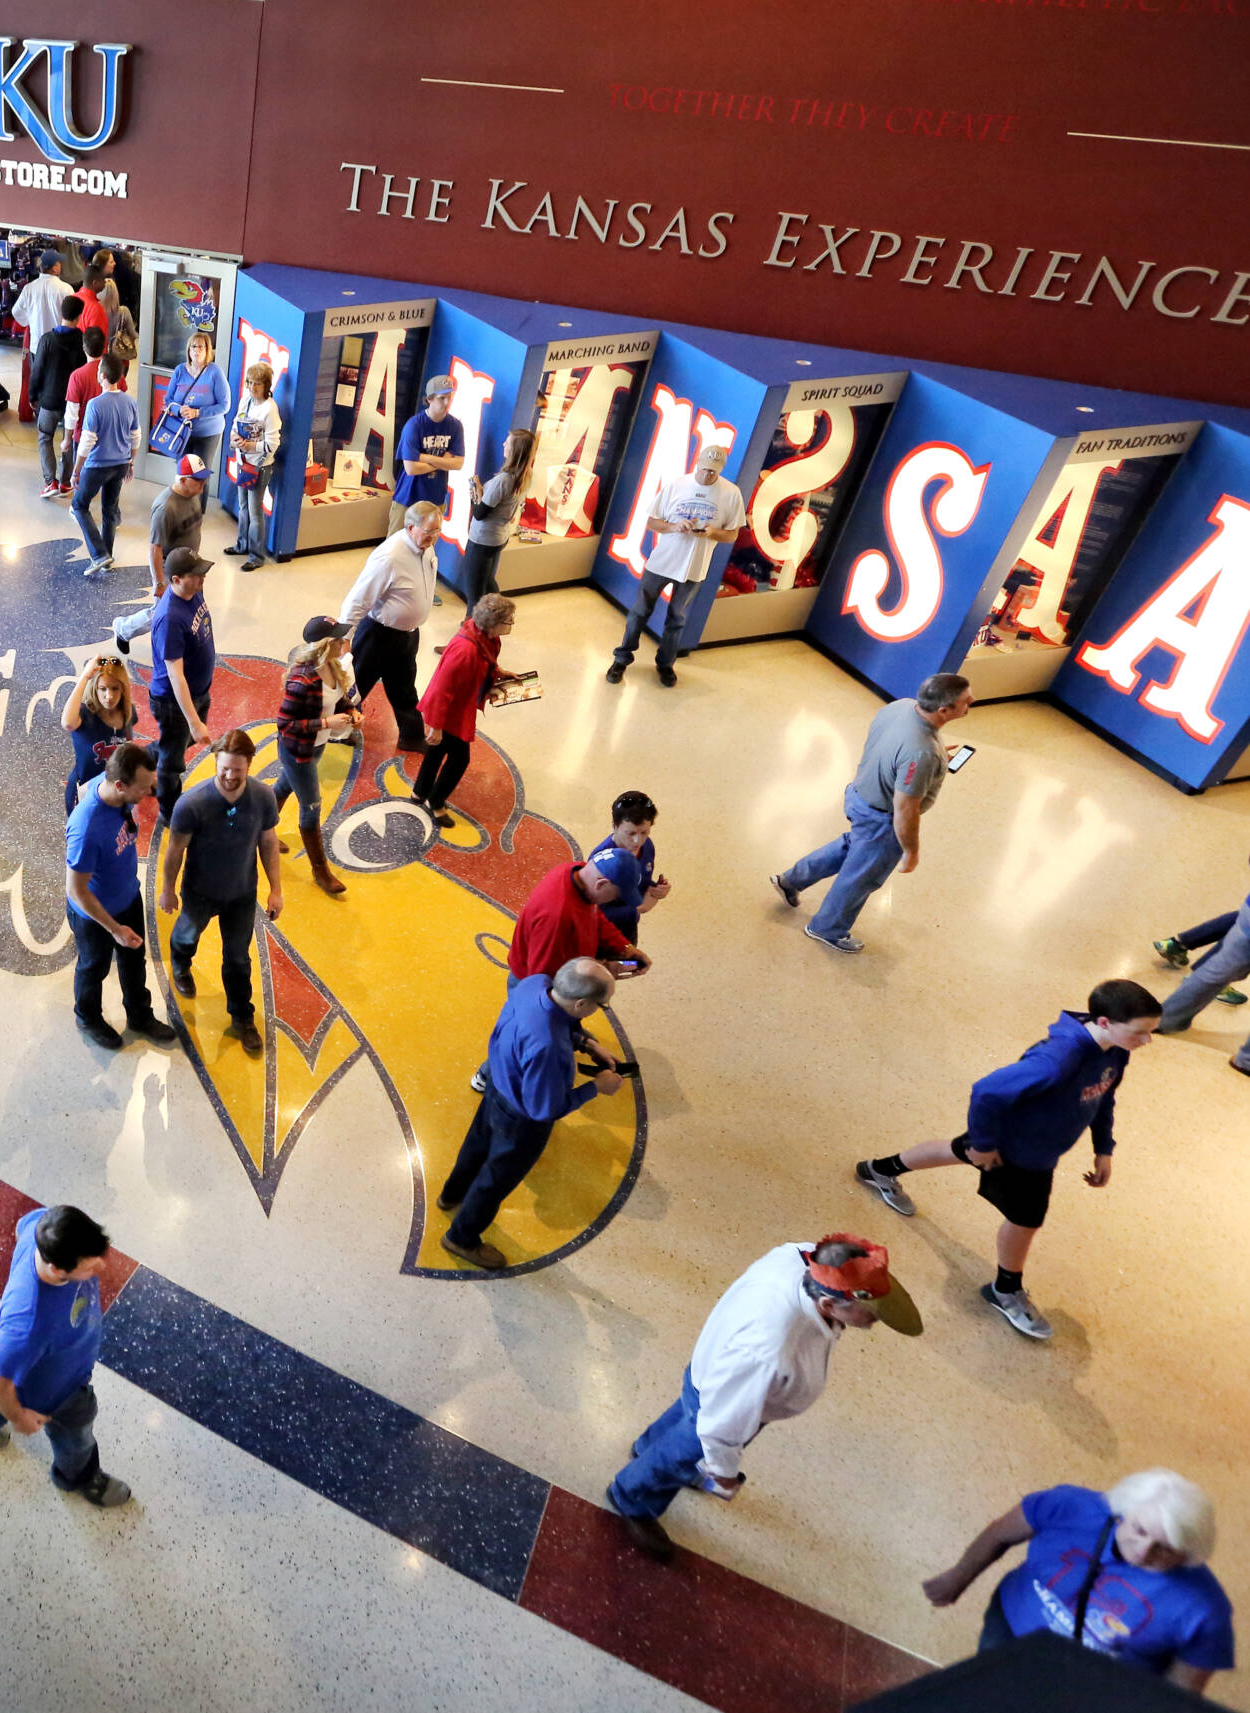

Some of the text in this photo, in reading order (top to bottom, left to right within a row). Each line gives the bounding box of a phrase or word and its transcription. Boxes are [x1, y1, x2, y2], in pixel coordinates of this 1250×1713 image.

[608, 83, 1021, 145] TOGETHER THEY CREATE
[340, 162, 1250, 326] THE KANSAS EXPERIENCE
[192, 306, 204, 317] KU
[330, 307, 427, 328] CRIMSON & BLUE
[548, 340, 651, 362] MARCHING BAND
[802, 383, 883, 402] SPIRIT SQUAD
[423, 434, 452, 449] HEART
[1076, 431, 1186, 454] FAN TRADITIONS
